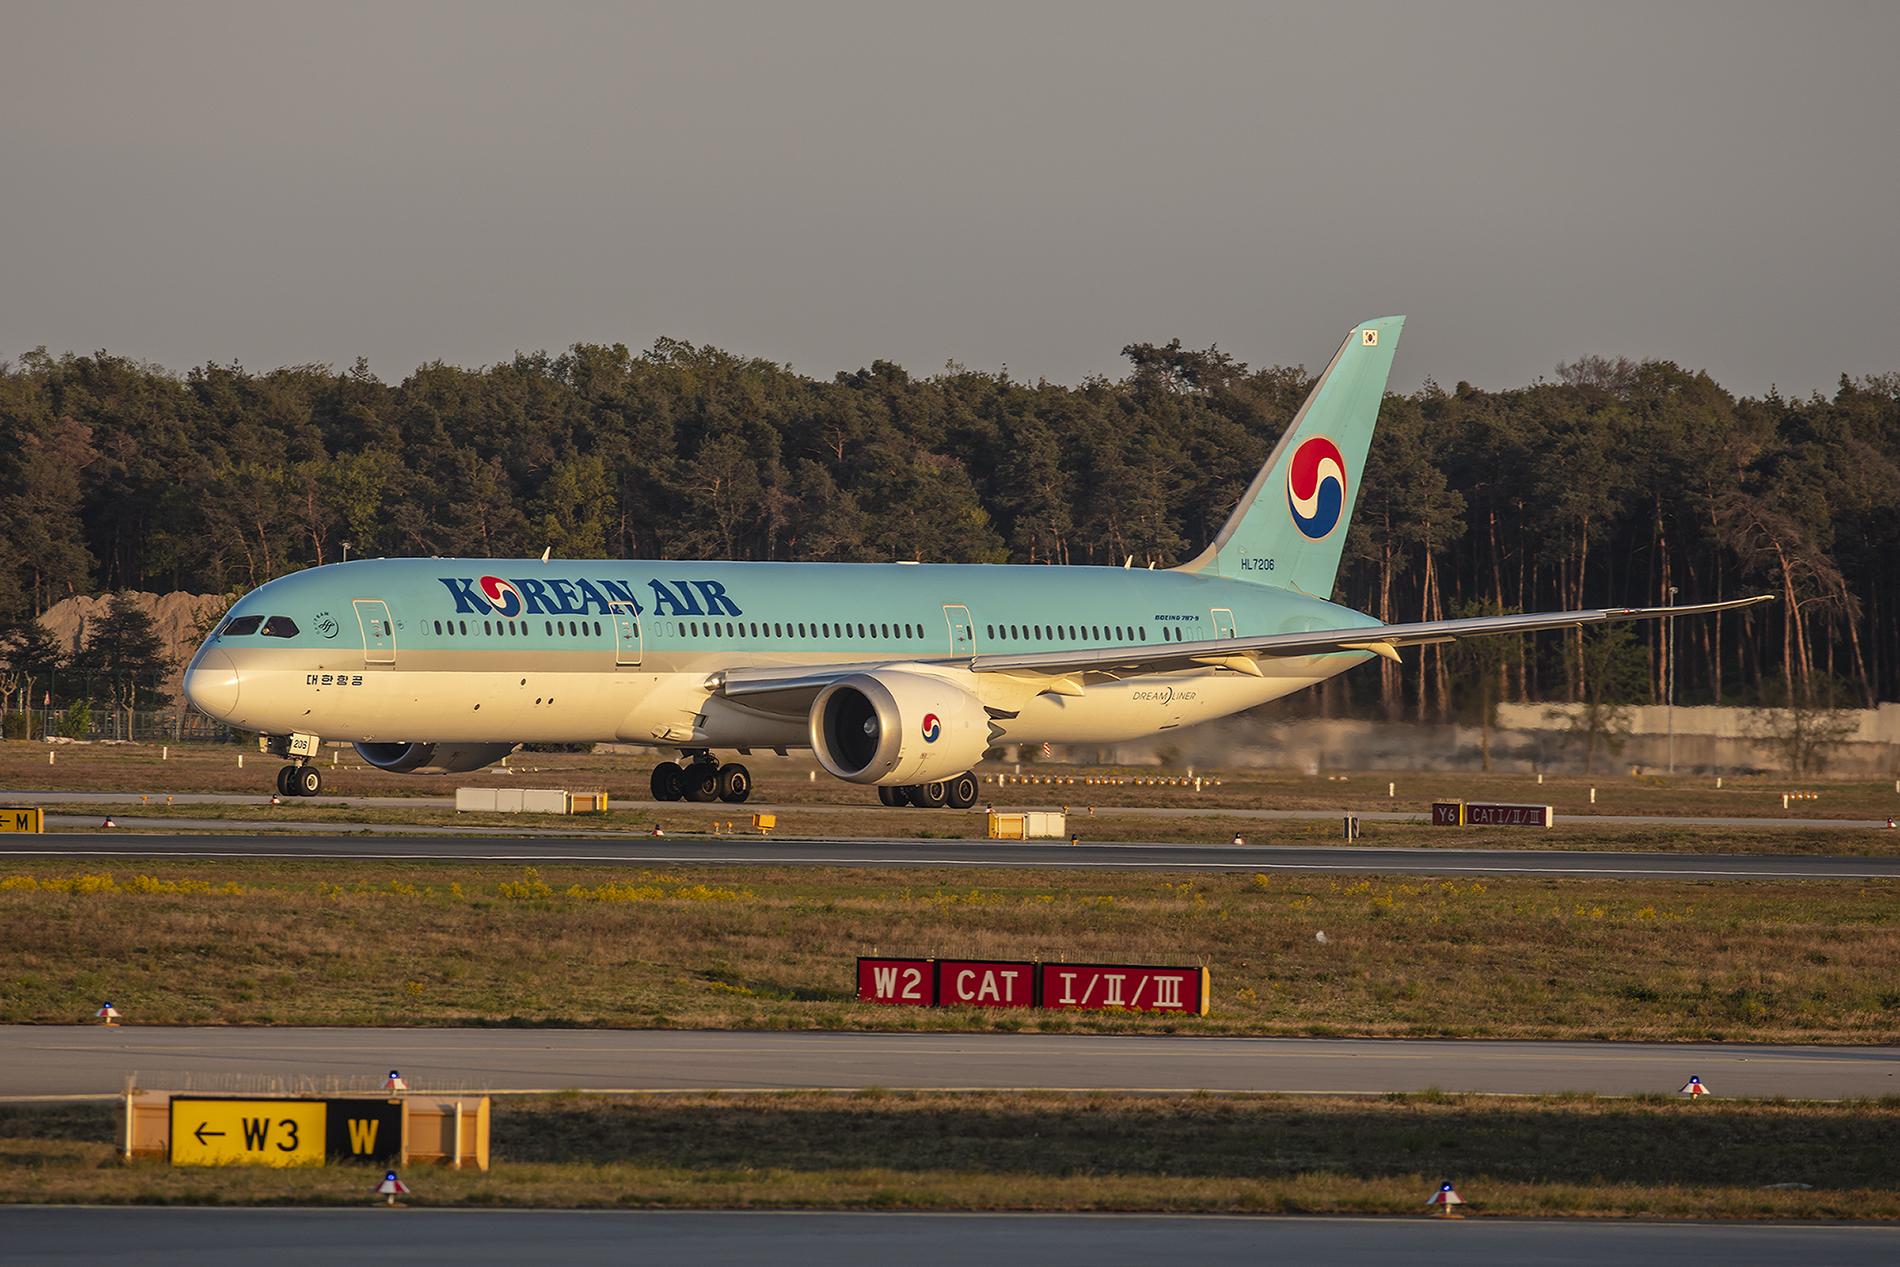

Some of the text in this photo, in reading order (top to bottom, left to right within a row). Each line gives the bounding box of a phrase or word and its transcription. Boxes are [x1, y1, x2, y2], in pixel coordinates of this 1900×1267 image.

[1241, 559, 1275, 571] HL7206
[437, 574, 743, 619] KOREAN AIR
[306, 674, 363, 686] 대한항공
[16, 813, 28, 830] M
[1438, 807, 1541, 824] Y6 CAT I/II/III
[873, 966, 1184, 1008] W2 CAT I/II/III
[241, 1117, 380, 1155] W3 W
